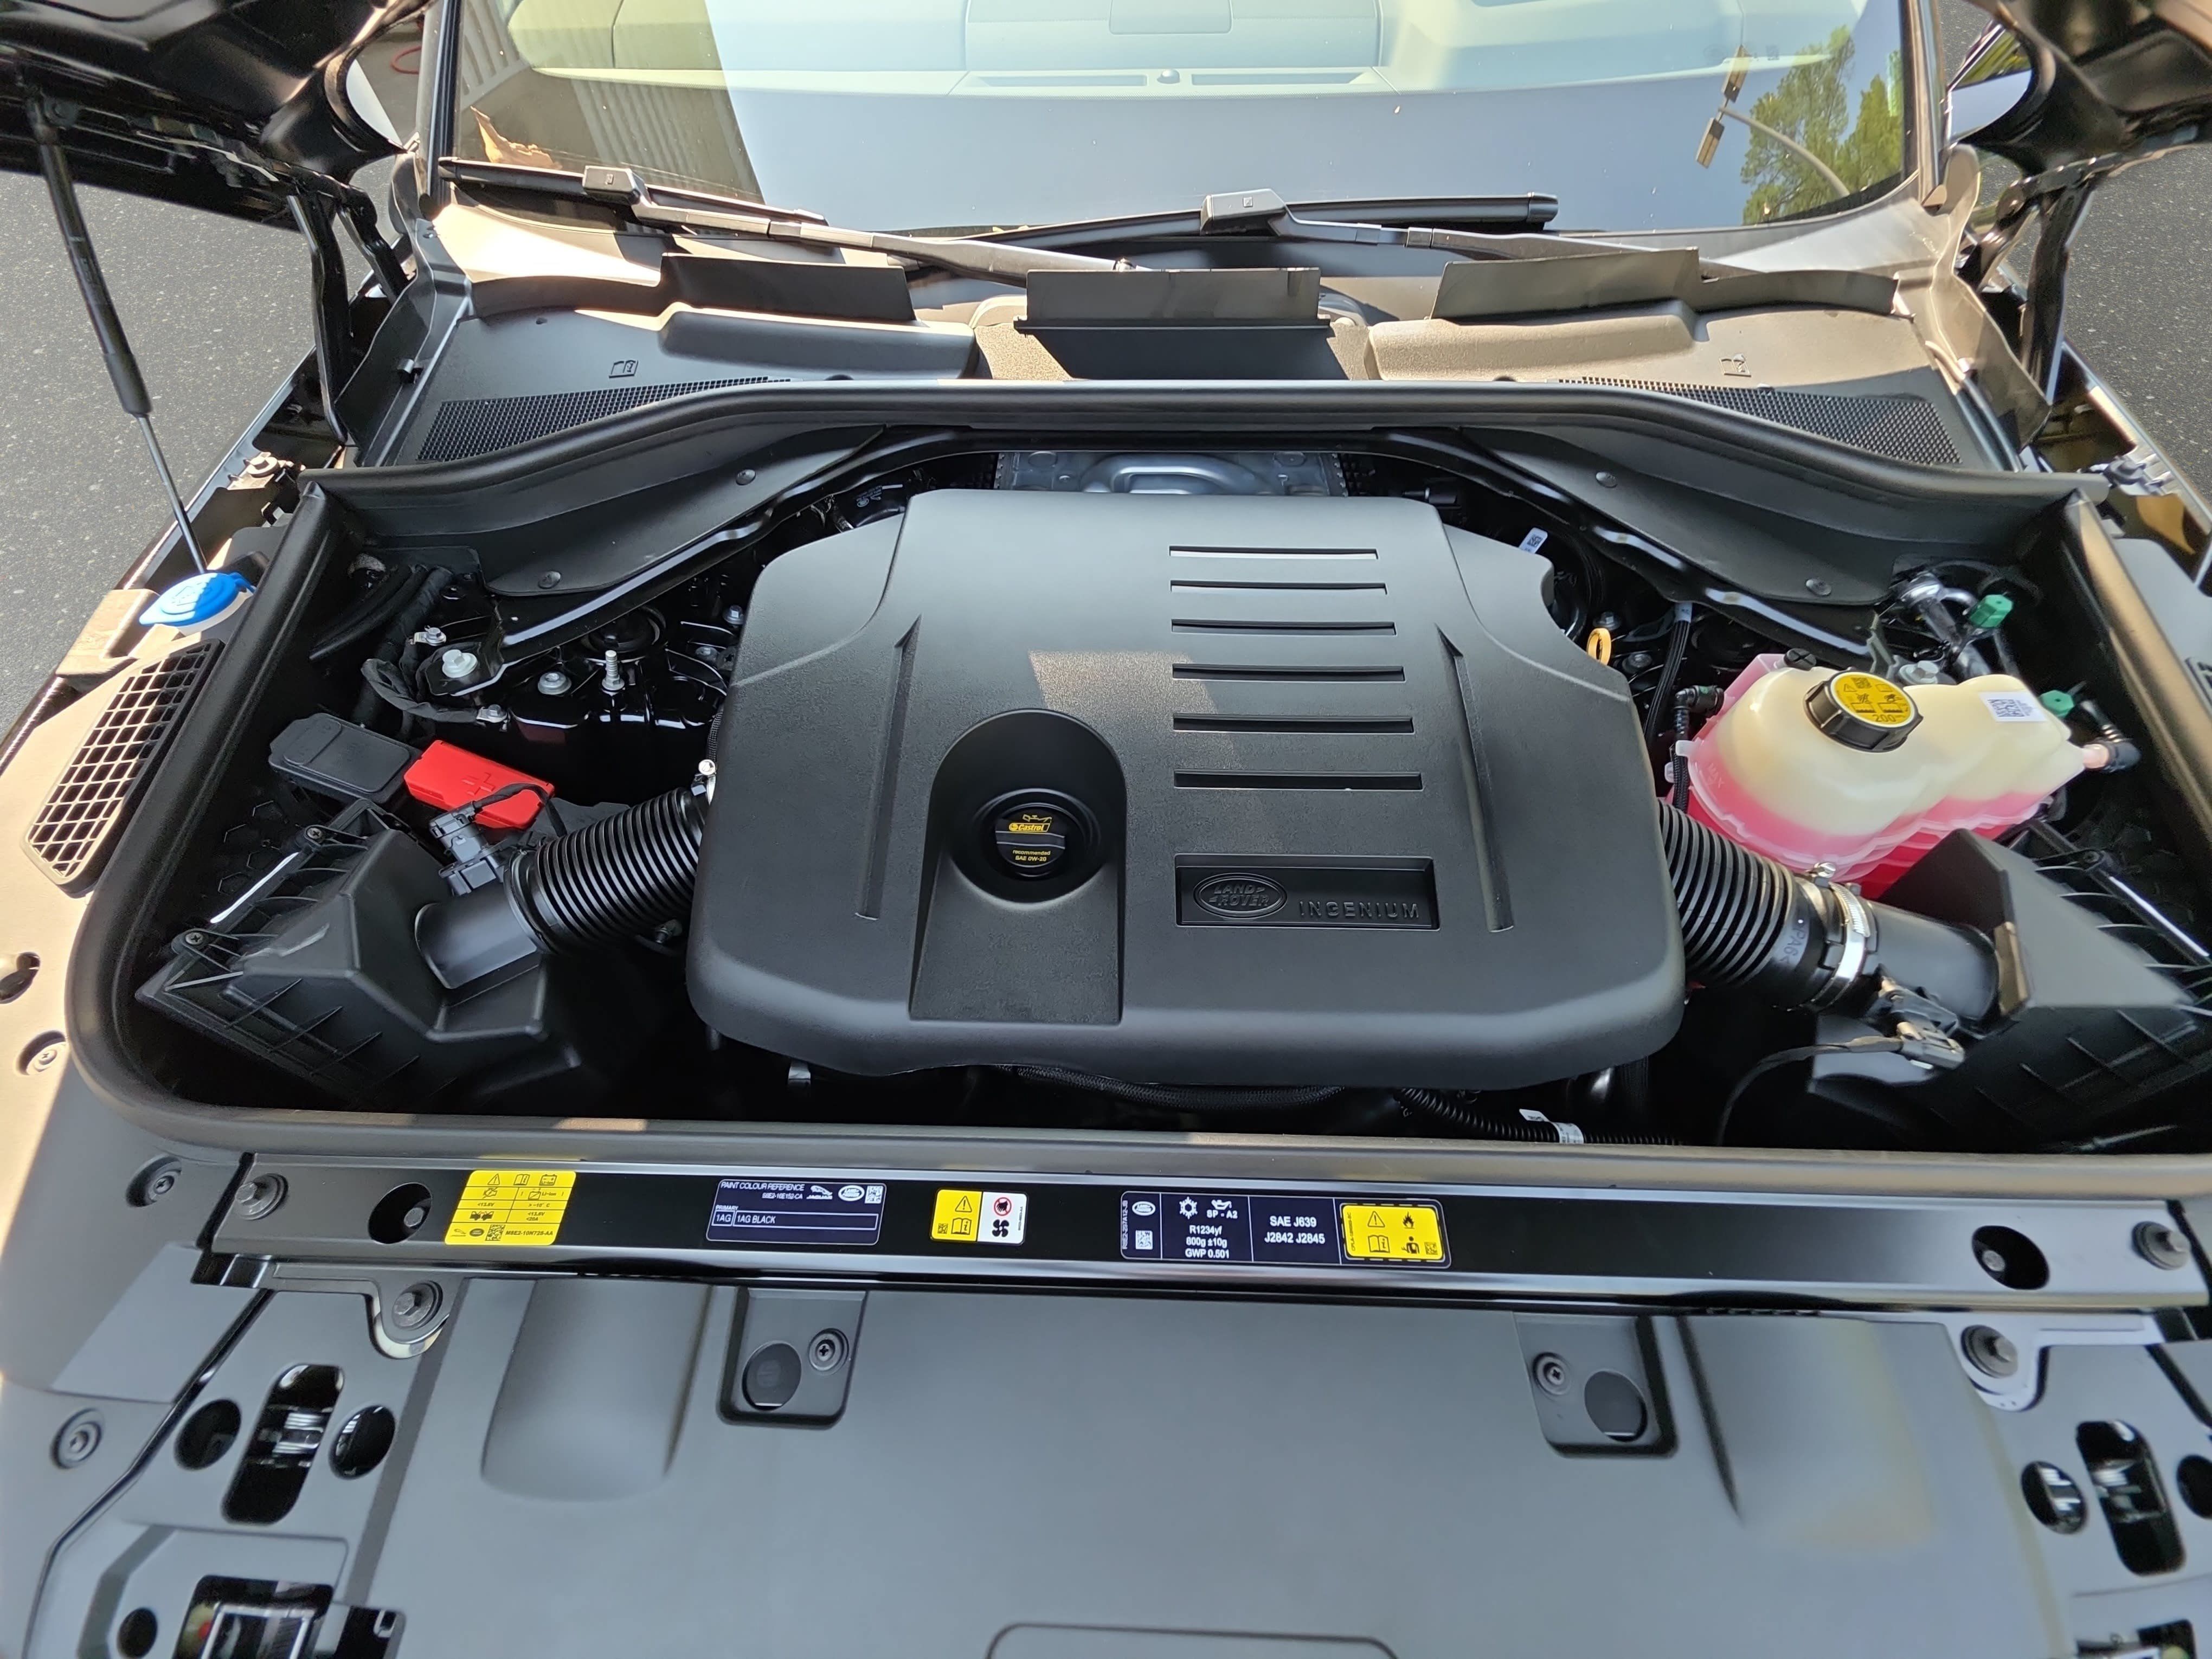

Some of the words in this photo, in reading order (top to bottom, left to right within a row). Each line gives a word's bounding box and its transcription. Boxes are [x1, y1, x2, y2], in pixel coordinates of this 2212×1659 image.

[1872, 714, 1896, 722] 200
[1214, 884, 1255, 895] LAND
[1218, 894, 1269, 906] ROVER
[1300, 901, 1419, 918] INGENIUM
[721, 1181, 739, 1189] PAINT
[716, 1214, 731, 1223] 1AG
[737, 1214, 751, 1223] 1AG
[752, 1216, 776, 1224] BLACK
[1206, 1210, 1219, 1218] SP
[1226, 1211, 1238, 1219] A2
[1270, 1215, 1291, 1227] SAE
[1294, 1216, 1317, 1228] J639
[1189, 1225, 1223, 1236] R1234yf
[1186, 1237, 1206, 1248] 800g
[1207, 1238, 1227, 1249] ±10g
[1264, 1232, 1294, 1244] J2842
[1296, 1232, 1325, 1244] J2845
[1185, 1249, 1206, 1258] GWP
[1207, 1249, 1230, 1258] 0.501
